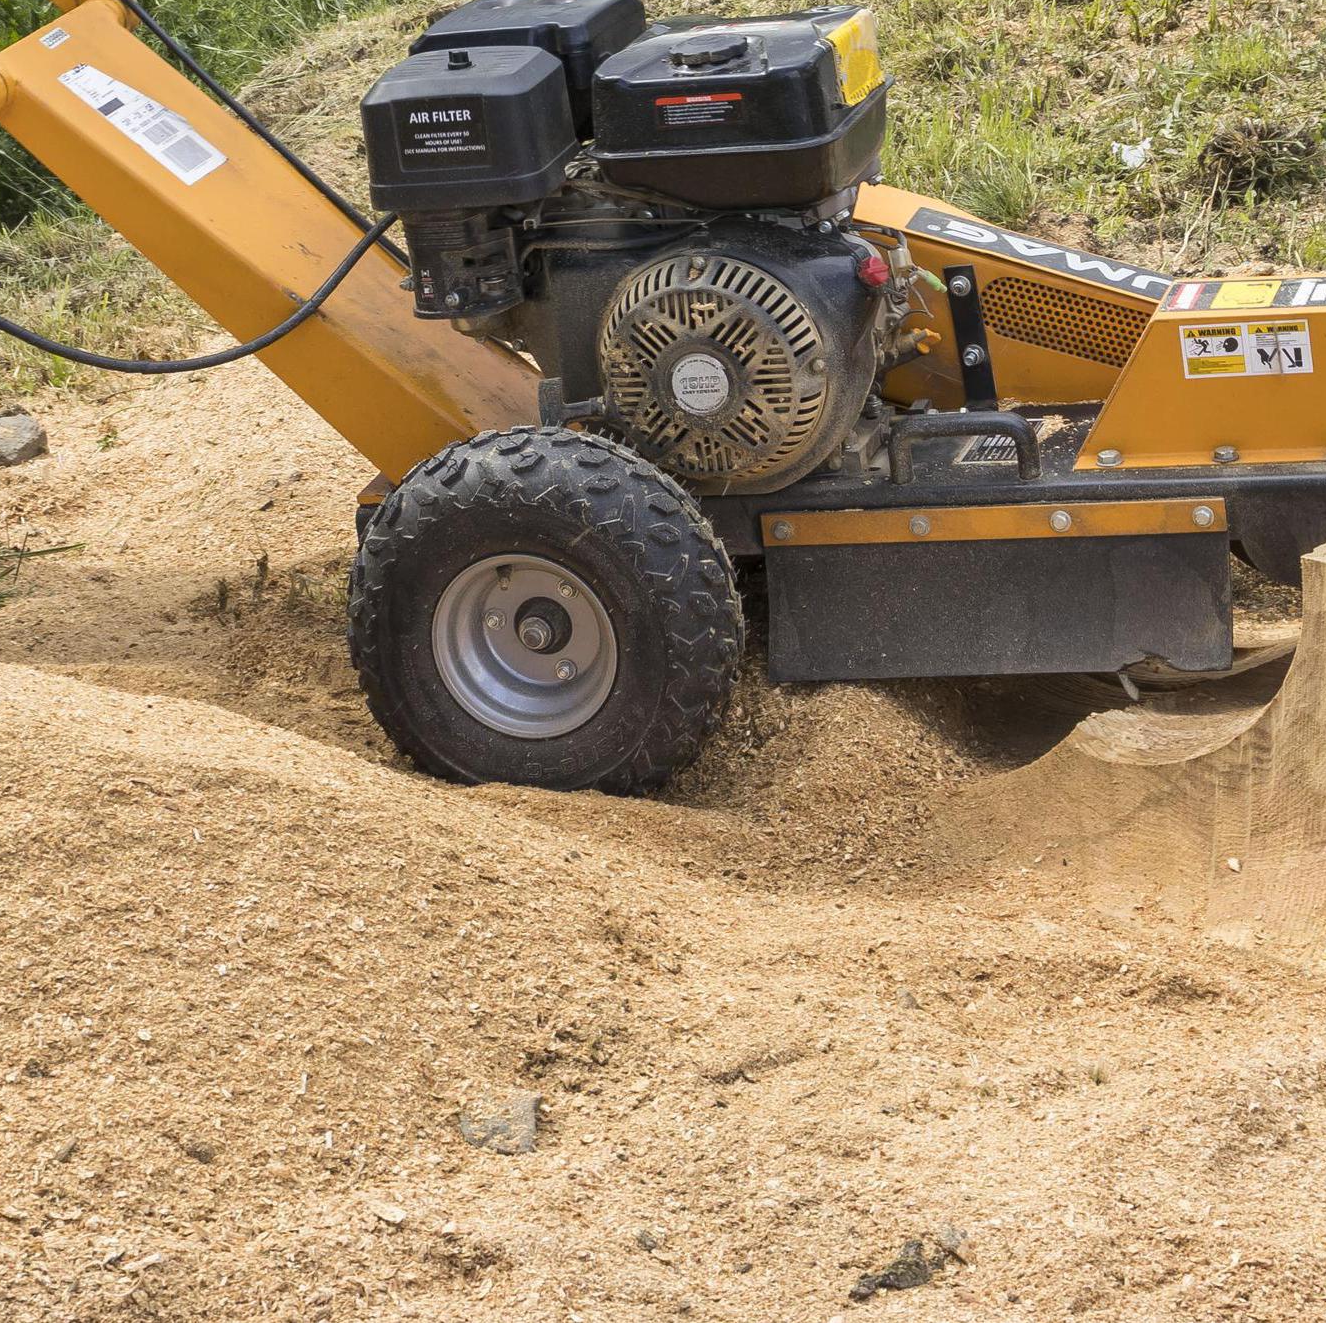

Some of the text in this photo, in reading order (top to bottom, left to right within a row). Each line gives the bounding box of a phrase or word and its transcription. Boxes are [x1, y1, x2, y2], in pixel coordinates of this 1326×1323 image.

[409, 109, 472, 124] AIR FILTER
[1197, 327, 1237, 337] WARNING
[1266, 324, 1299, 333] WRNING
[679, 375, 721, 390] 15HP
